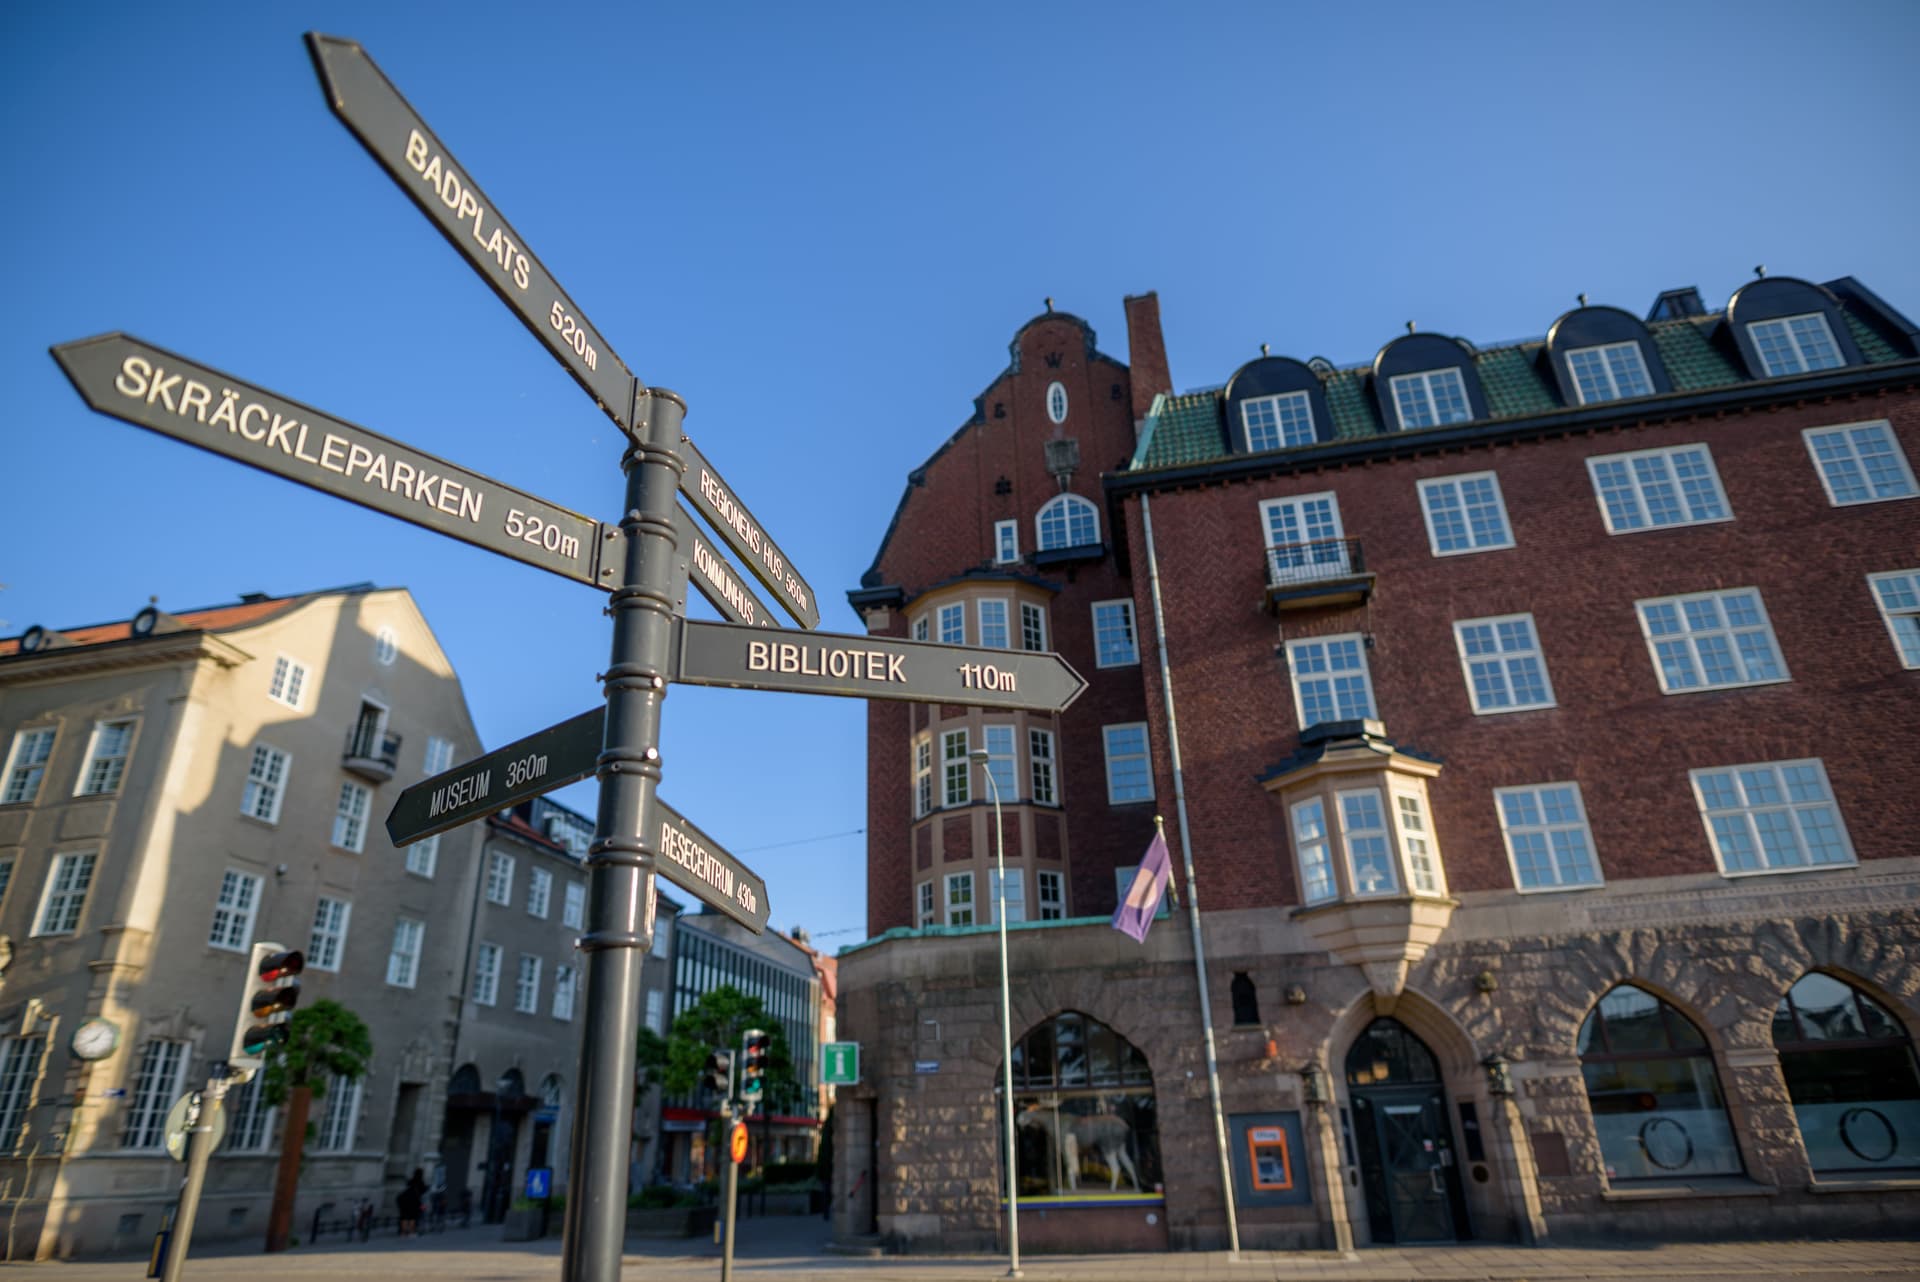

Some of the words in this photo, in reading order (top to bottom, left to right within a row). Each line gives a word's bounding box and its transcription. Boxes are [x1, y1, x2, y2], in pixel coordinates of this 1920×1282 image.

[406, 129, 530, 290] BADPLATS
[550, 300, 597, 371] 520m
[116, 357, 484, 522] SKRÄCKLEPARKEN
[505, 508, 580, 559] 520m
[693, 538, 754, 626] KOMMUNHUS
[700, 468, 760, 554] REGIONENS
[763, 542, 783, 581] HUS
[785, 572, 807, 611] 560m
[749, 641, 907, 682] BIBLIOTEK
[958, 663, 1016, 692] 110m
[429, 769, 491, 817] MUSEUM
[505, 754, 548, 788] 360m
[660, 822, 734, 898] RESECENTRUM
[736, 882, 757, 914] 430m
